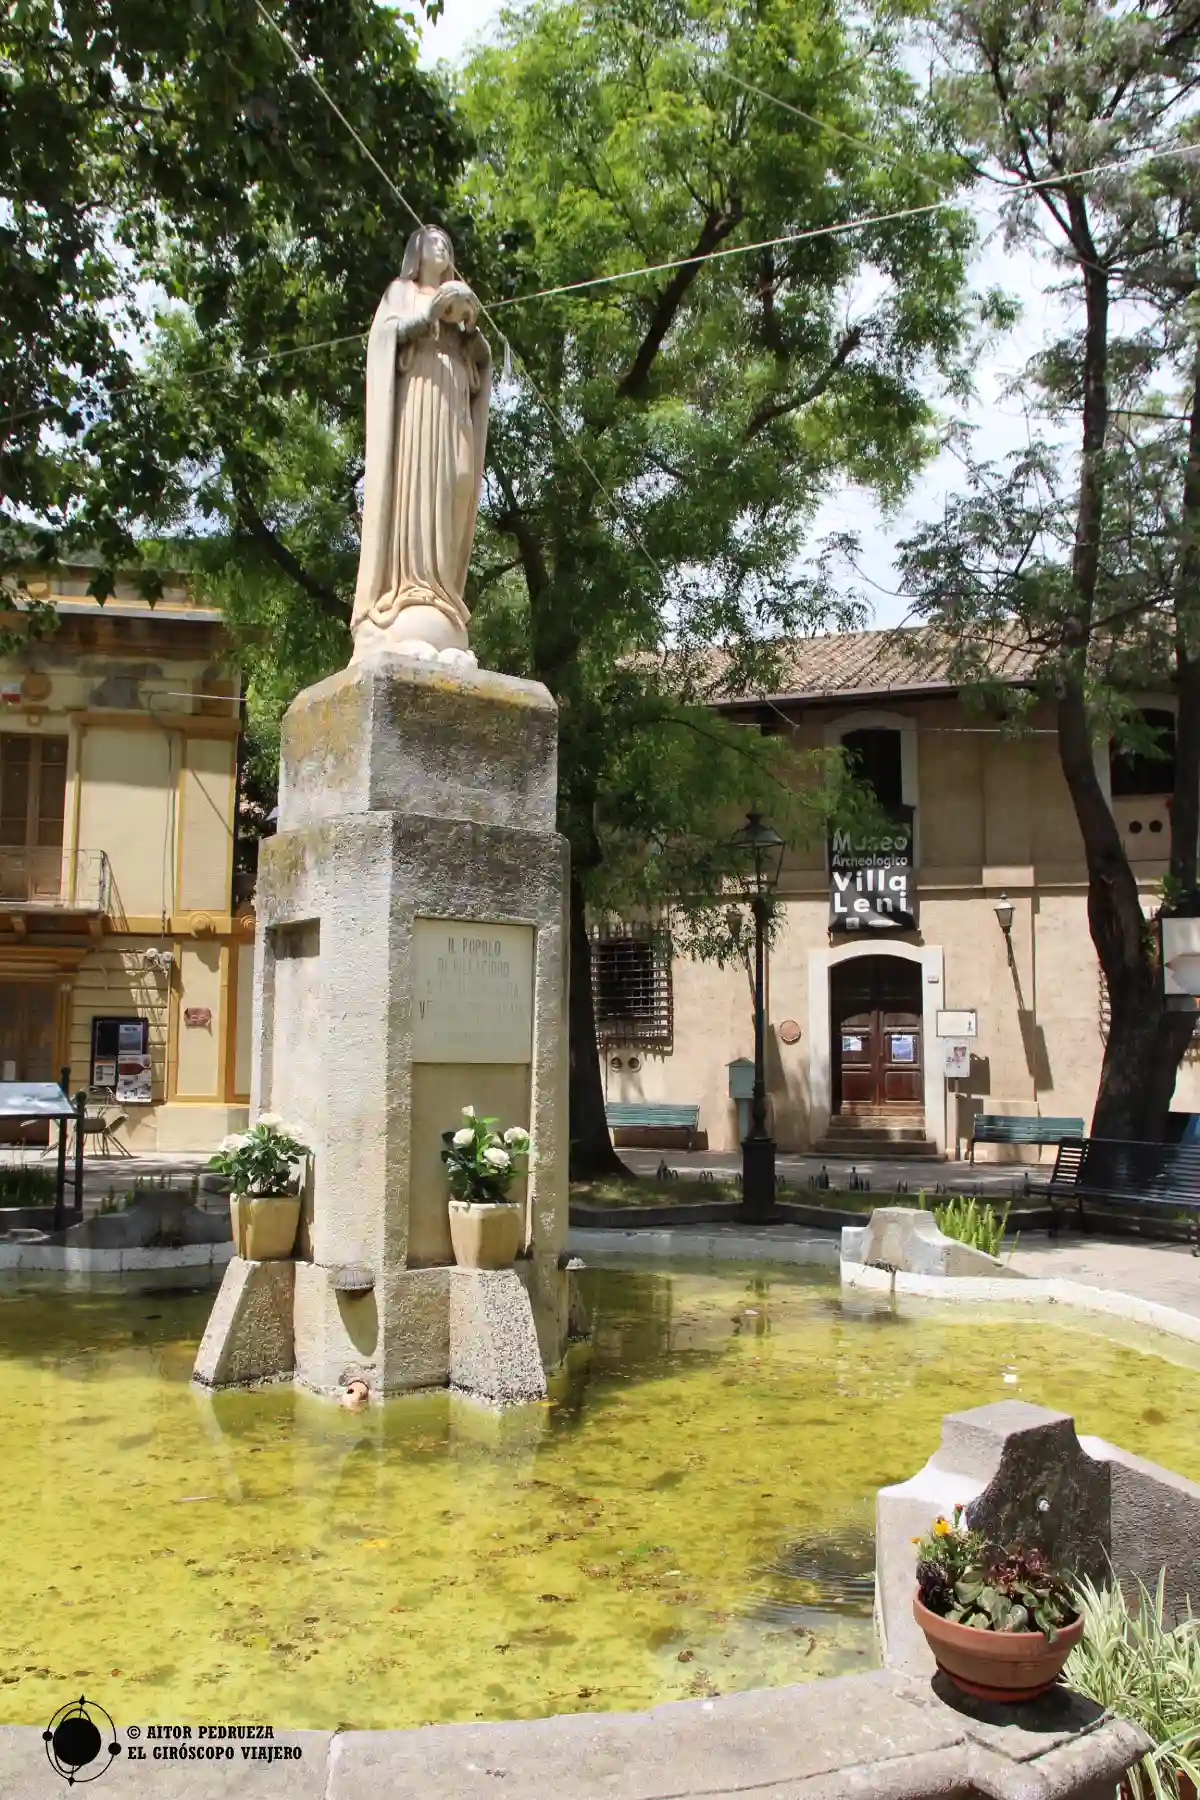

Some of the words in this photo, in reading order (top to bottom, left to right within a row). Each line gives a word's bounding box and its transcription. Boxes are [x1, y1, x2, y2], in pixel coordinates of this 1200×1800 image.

[832, 827, 908, 851] Museo
[831, 852, 908, 869] Archeologico
[832, 870, 907, 892] Villa
[834, 891, 907, 913] Leni
[462, 937, 502, 957] POPOLO
